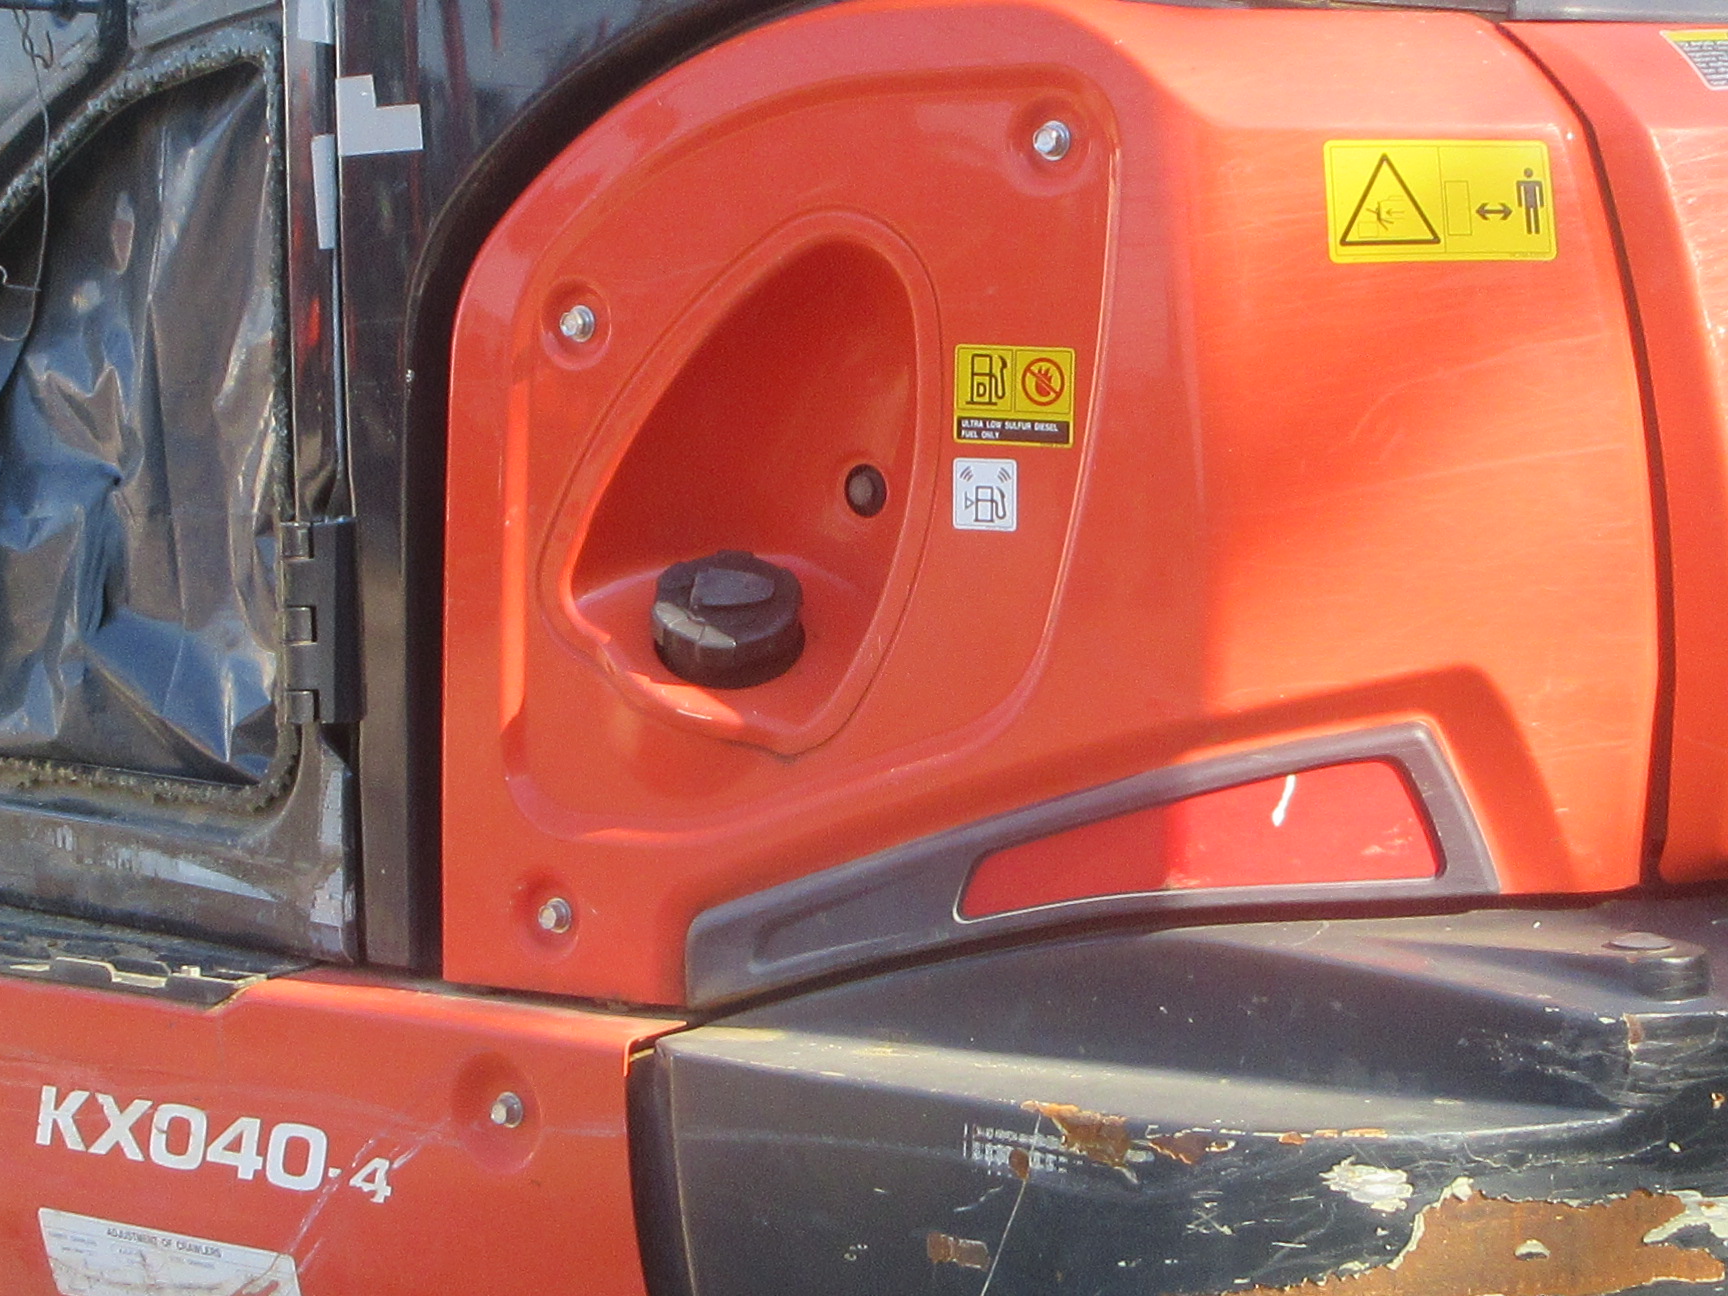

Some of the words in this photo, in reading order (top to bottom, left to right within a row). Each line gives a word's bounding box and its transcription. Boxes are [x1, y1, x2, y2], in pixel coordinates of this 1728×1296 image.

[961, 419, 983, 428] ULTRA
[986, 420, 1002, 429] LOW
[1004, 421, 1032, 431] SULFUR
[1034, 422, 1058, 432] DIESEL
[961, 430, 978, 438] FUEL
[981, 431, 1000, 439] ONLY
[107, 1227, 157, 1246] ADJUSTMENT
[161, 1238, 172, 1247] OF
